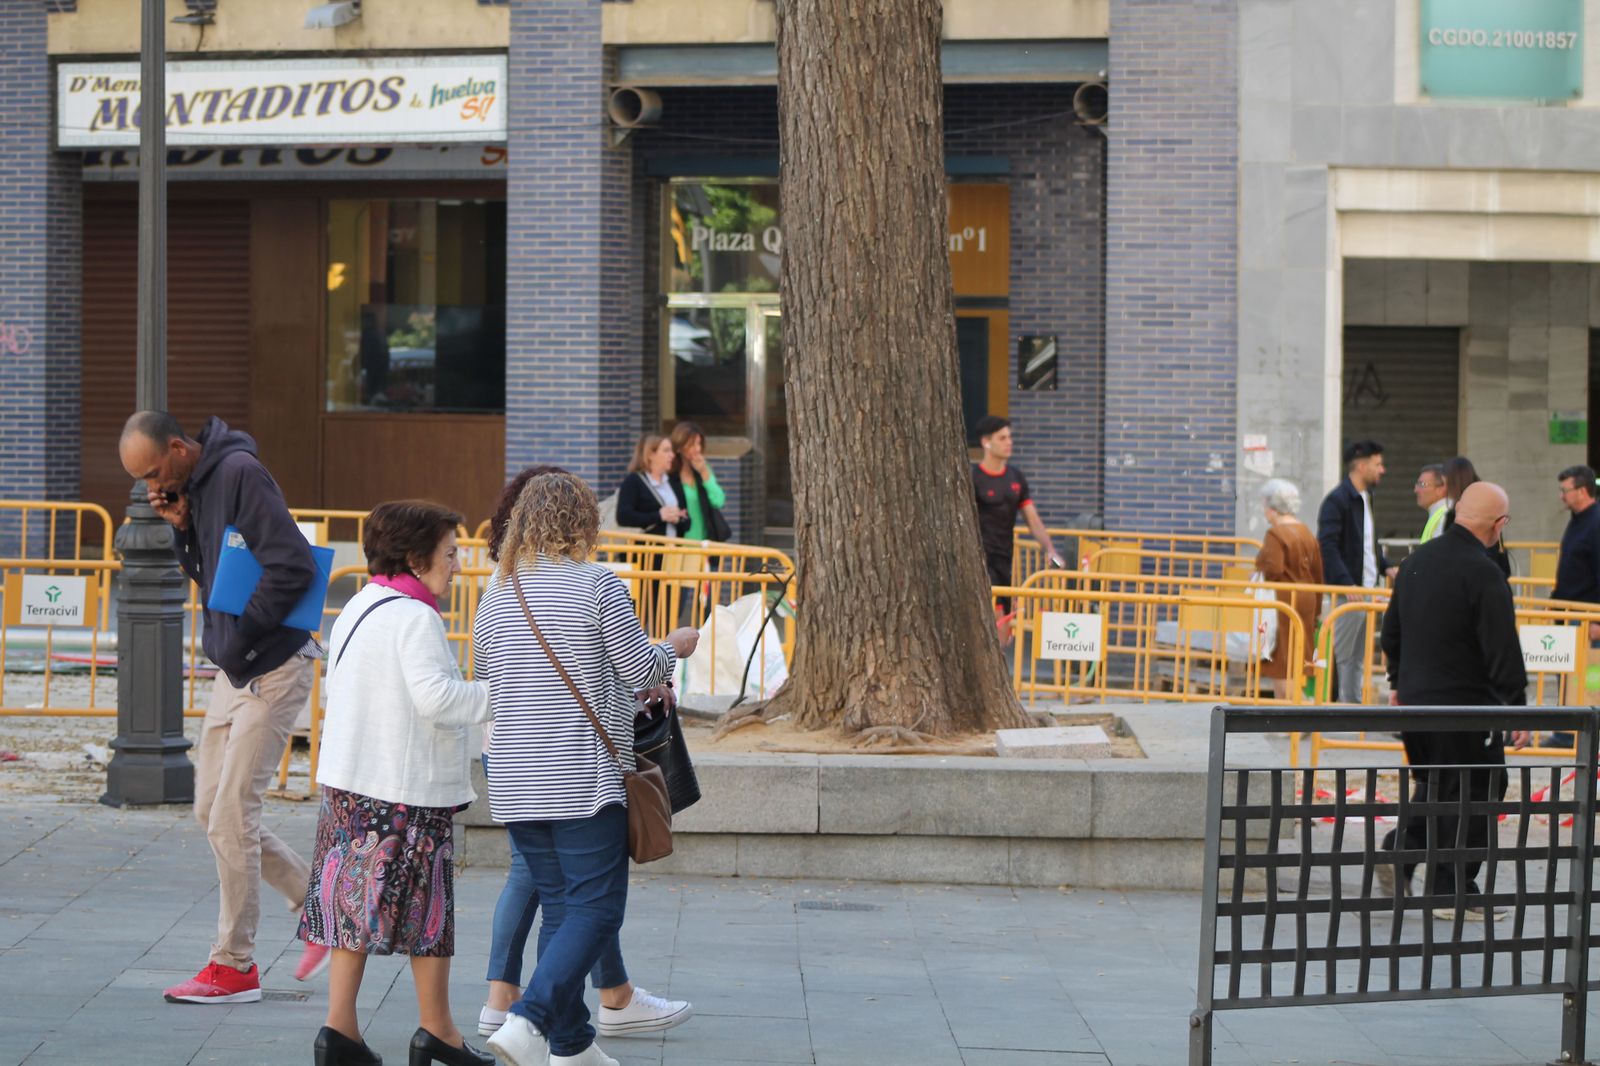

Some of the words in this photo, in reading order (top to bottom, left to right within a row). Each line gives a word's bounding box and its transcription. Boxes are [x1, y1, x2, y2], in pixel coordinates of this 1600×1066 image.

[1428, 28, 1578, 49] CGDO.21001857
[69, 75, 141, 93] D'Men
[429, 77, 496, 109] huelva
[692, 226, 754, 251] Plaza
[762, 226, 782, 255] Q
[26, 604, 78, 616] Terracivil
[1046, 640, 1094, 652] Terracivil
[1522, 652, 1570, 663] Terracivil
